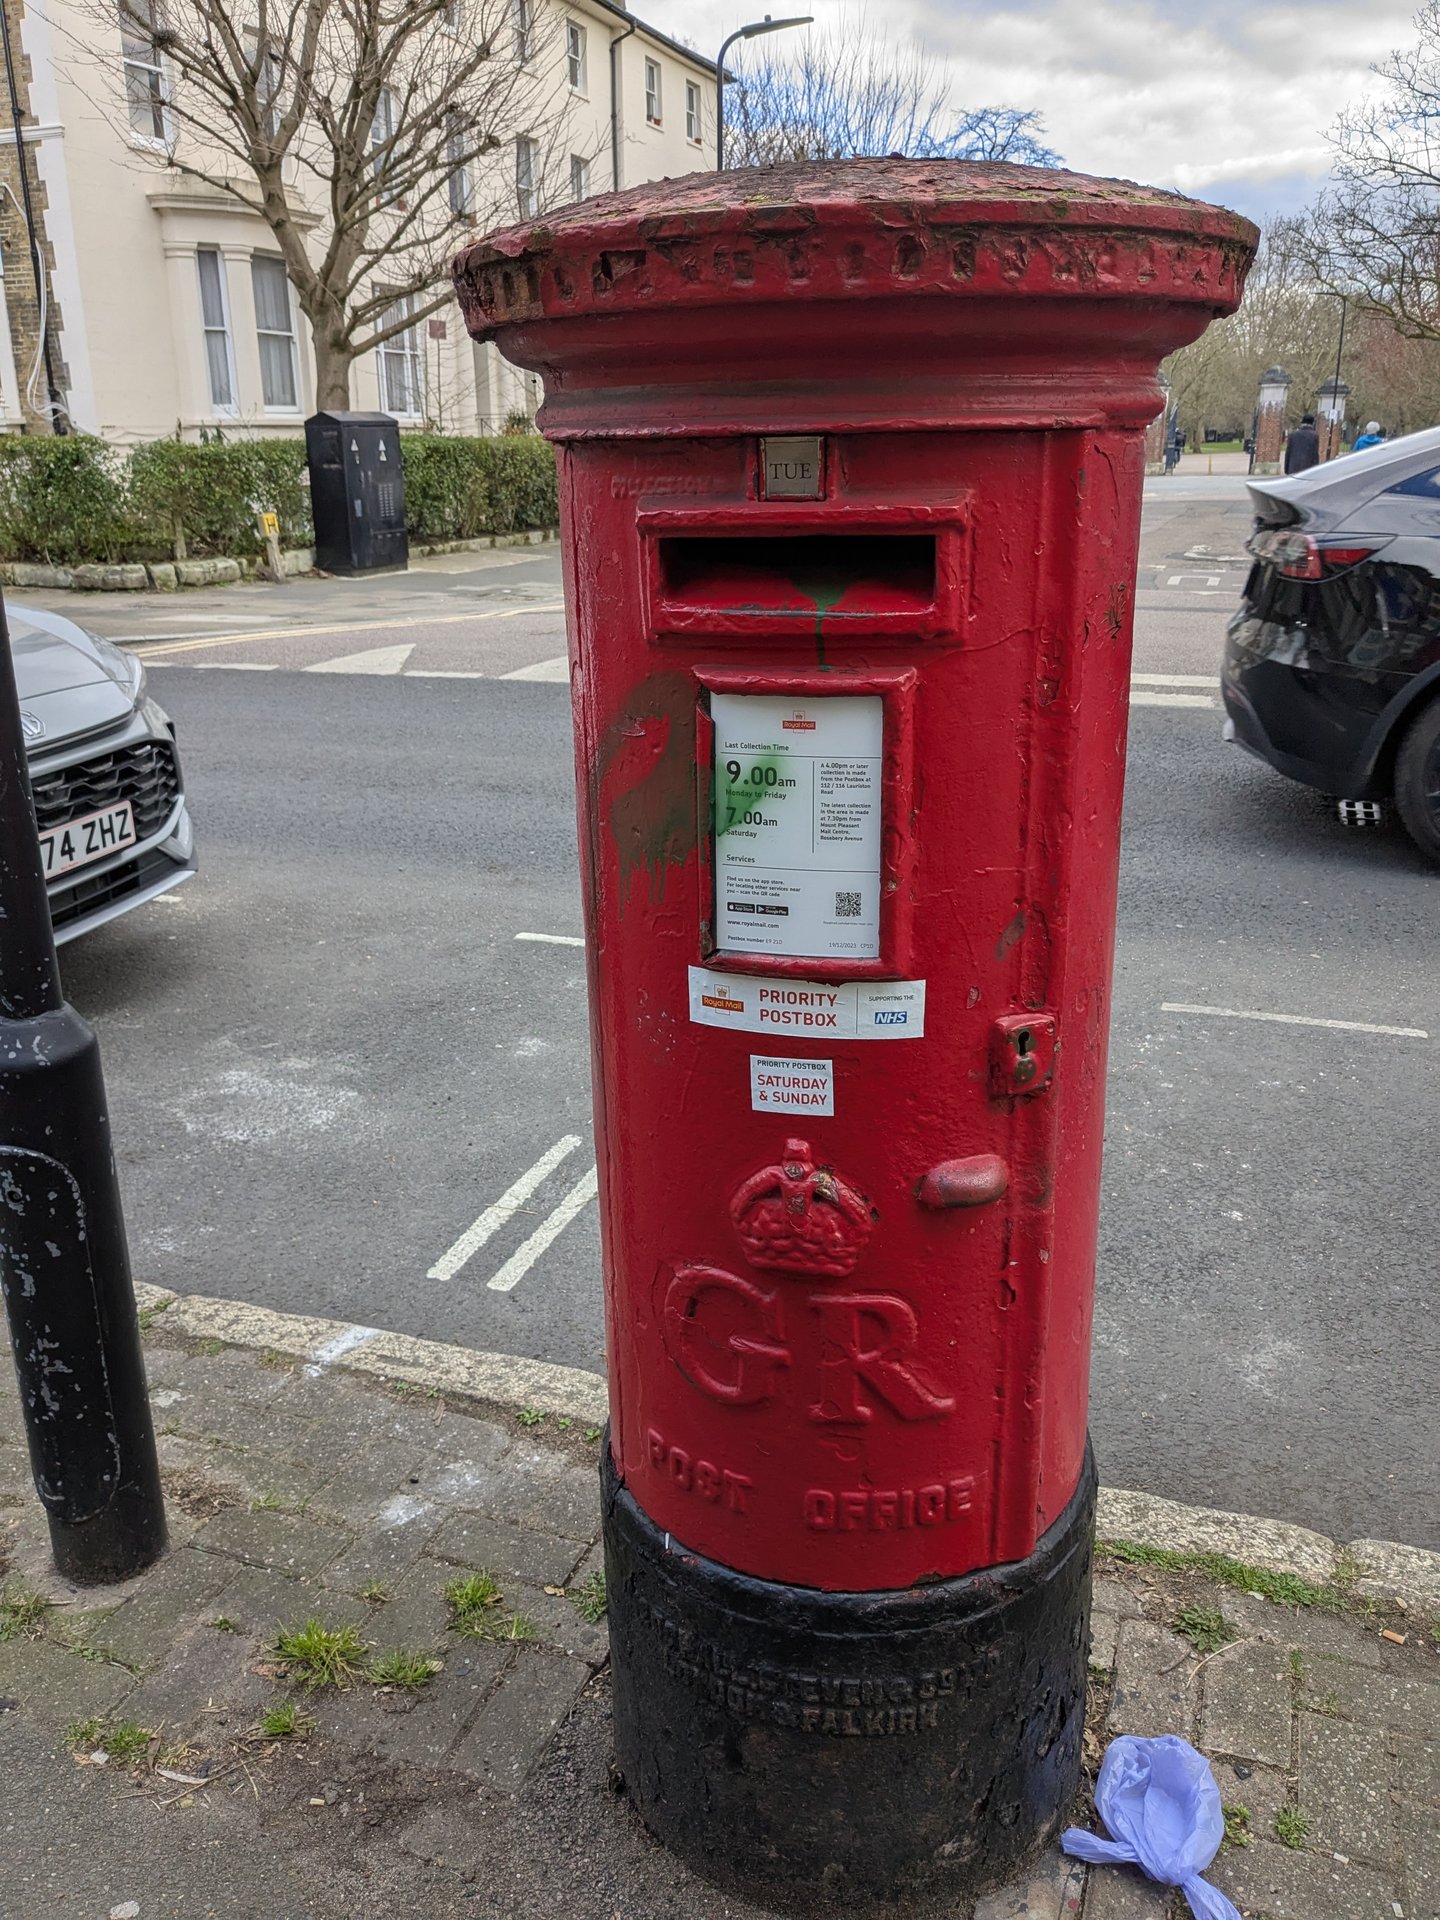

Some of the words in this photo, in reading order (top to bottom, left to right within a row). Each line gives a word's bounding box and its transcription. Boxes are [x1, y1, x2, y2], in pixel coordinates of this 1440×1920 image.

[769, 462, 812, 480] TUE
[783, 721, 800, 729] Royal
[740, 743, 771, 751] Collection
[726, 760, 796, 787] 9.00am
[726, 789, 753, 798] Monday
[764, 791, 787, 800] Friday
[726, 807, 778, 826] 7.00am
[82, 808, 131, 855] ZHZ
[726, 829, 757, 838] Saturday
[727, 855, 756, 863] Services
[727, 920, 779, 929] www.royalmail.com
[703, 996, 724, 1008] Royal
[724, 1000, 742, 1010] Mail
[759, 989, 837, 1007] PRIORITY
[759, 1010, 837, 1027] POSTBOX
[876, 1012, 905, 1024] NHS
[757, 1059, 790, 1069] PRIORITY
[792, 1062, 826, 1070] POSTBOX
[757, 1074, 828, 1090] SATURDAY
[759, 1090, 768, 1102] &
[772, 1091, 827, 1106] SUNDAY
[648, 1427, 753, 1514] POST
[803, 1475, 975, 1530] OFFICE
